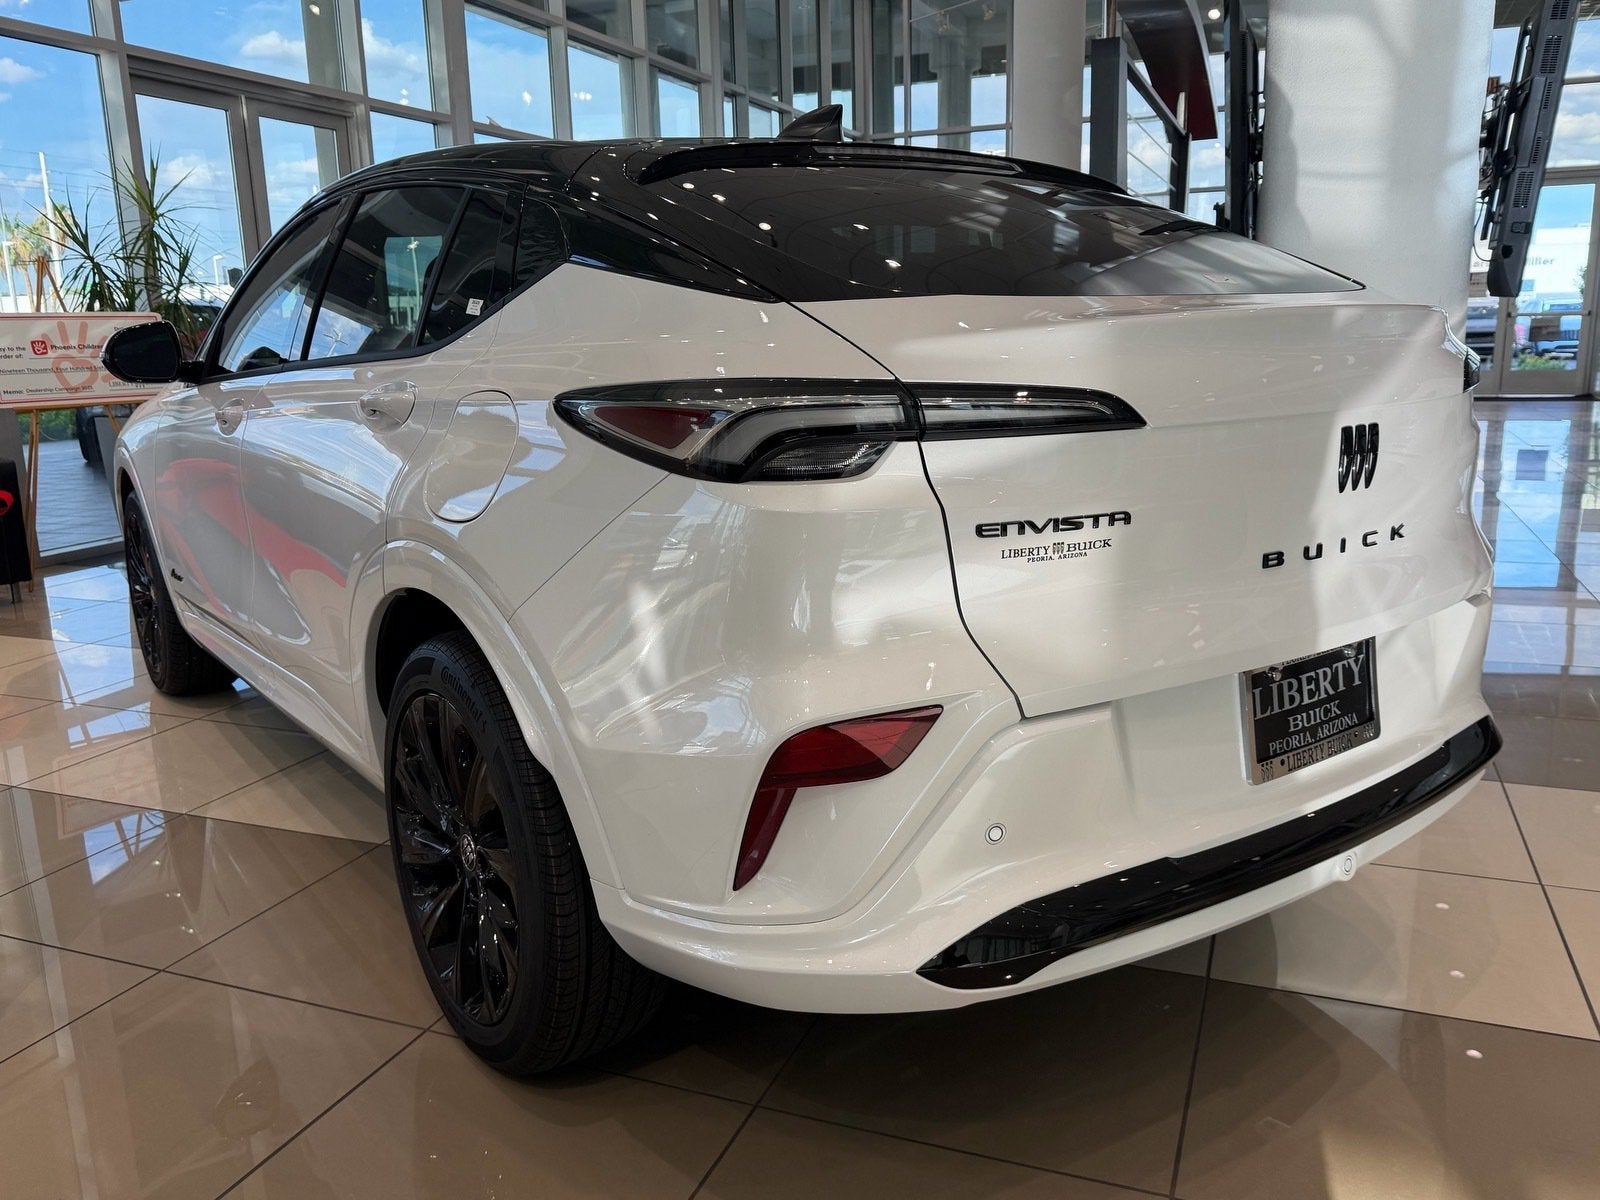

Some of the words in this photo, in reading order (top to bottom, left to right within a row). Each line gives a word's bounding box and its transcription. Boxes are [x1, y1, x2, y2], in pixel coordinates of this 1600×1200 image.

[975, 510, 1132, 538] ENVISTA
[1001, 545, 1051, 559] LIBERTY
[1066, 538, 1112, 553] BUICK
[1057, 551, 1088, 560] ARIZONA
[1262, 523, 1405, 569] BUICK
[1252, 654, 1366, 720] LIBERTY
[1288, 700, 1341, 732] BUICK
[1316, 712, 1359, 740] ARIZONA
[1286, 743, 1325, 772] LIBERTY
[1327, 732, 1353, 757] BUICK
